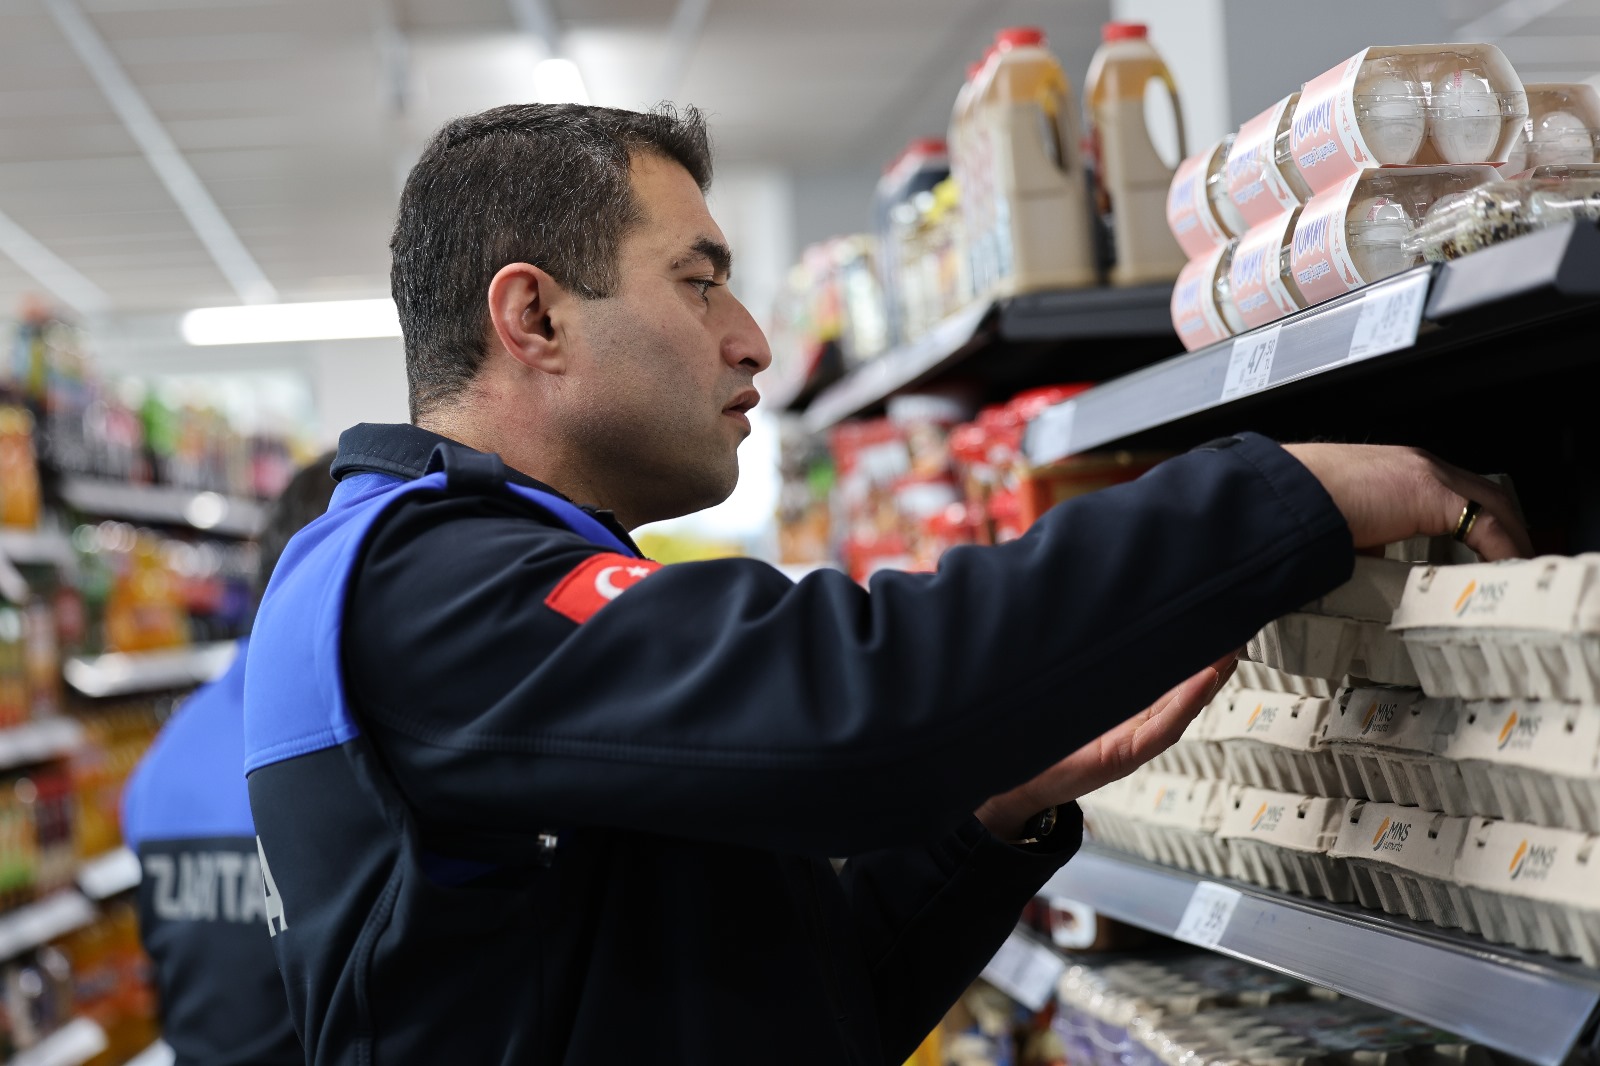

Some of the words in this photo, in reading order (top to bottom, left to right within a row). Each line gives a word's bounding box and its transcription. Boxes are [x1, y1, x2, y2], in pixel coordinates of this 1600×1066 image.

[1477, 581, 1508, 602] MNS
[1375, 703, 1398, 721] MNS
[1515, 715, 1543, 737] MNS
[1387, 821, 1412, 842] MNS
[1526, 844, 1558, 869] MNS
